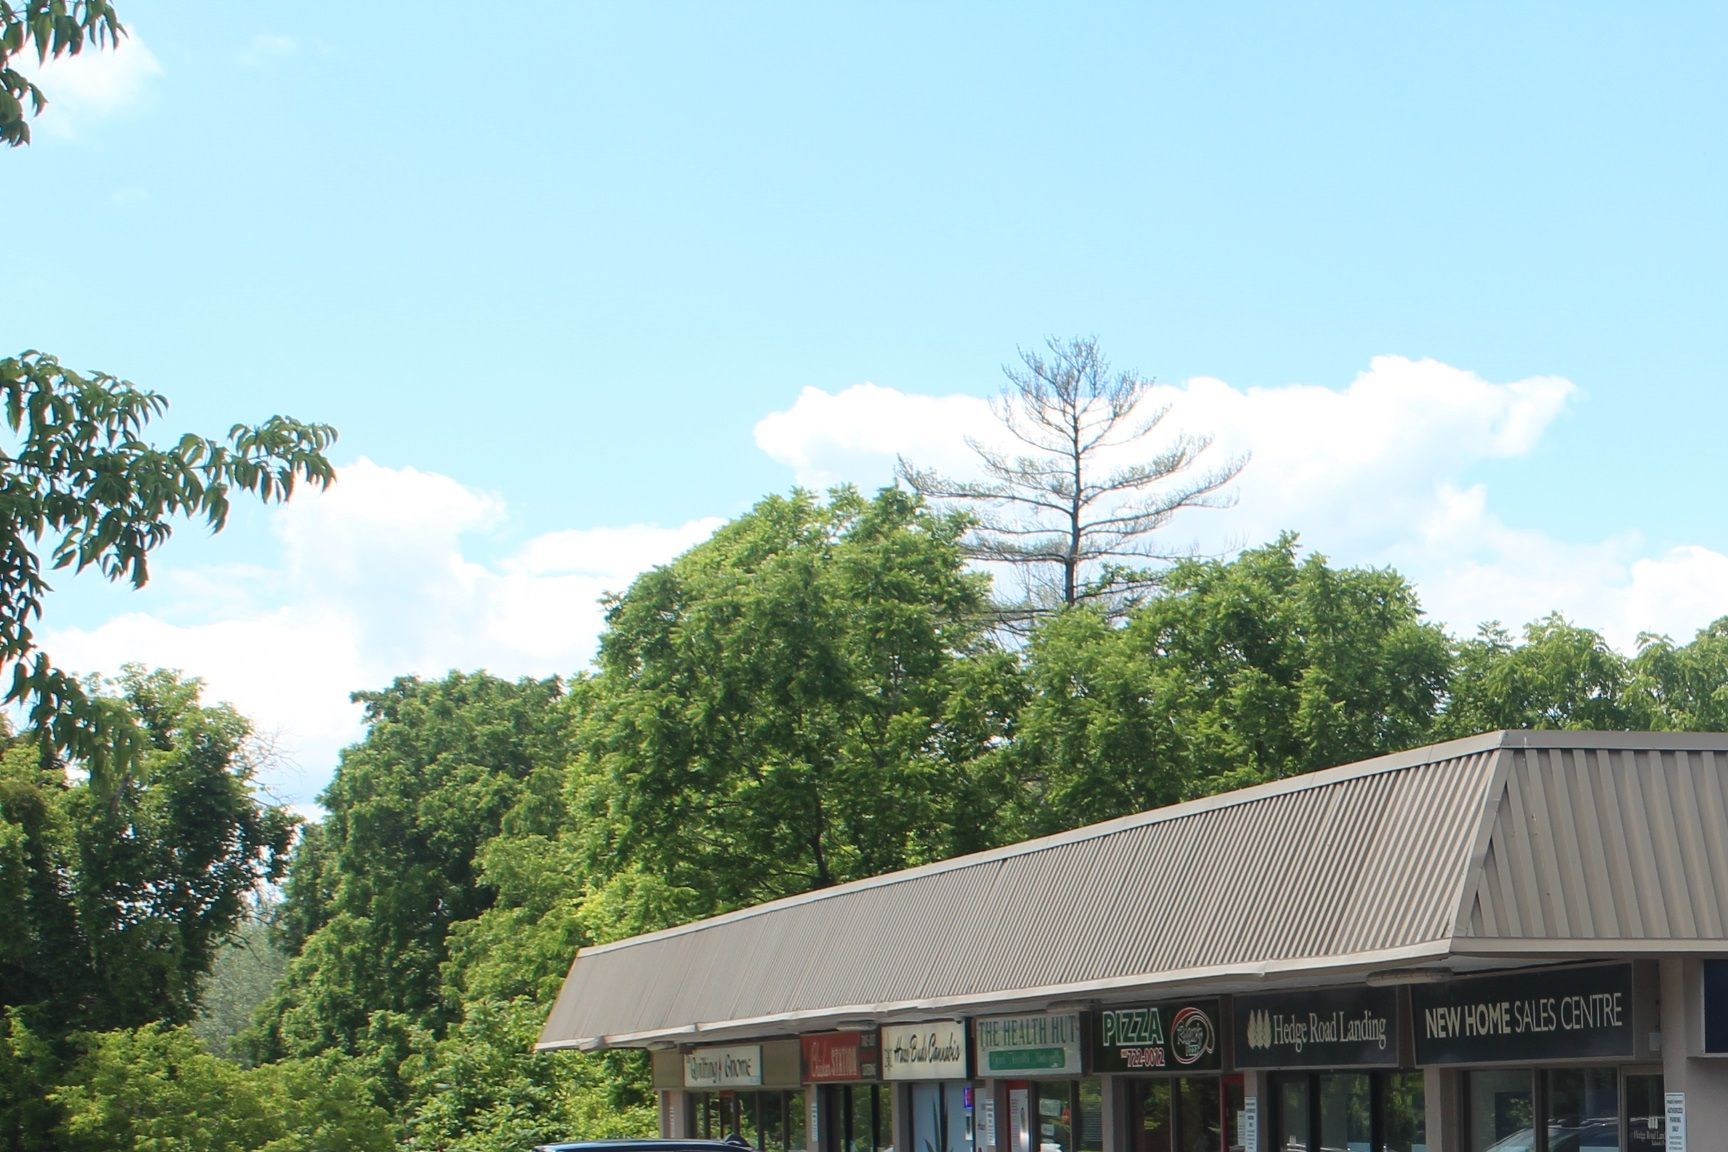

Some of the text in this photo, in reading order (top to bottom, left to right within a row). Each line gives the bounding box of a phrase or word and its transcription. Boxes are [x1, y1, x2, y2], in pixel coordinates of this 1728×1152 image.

[979, 1015, 1077, 1048] THE HEALTH HUT
[1102, 1007, 1165, 1047] PIZZA
[1273, 1009, 1387, 1053] Hedge Road Landing
[1425, 992, 1623, 1039] NEW HOME SALES CENTRE
[928, 1031, 961, 1063] Cannabis
